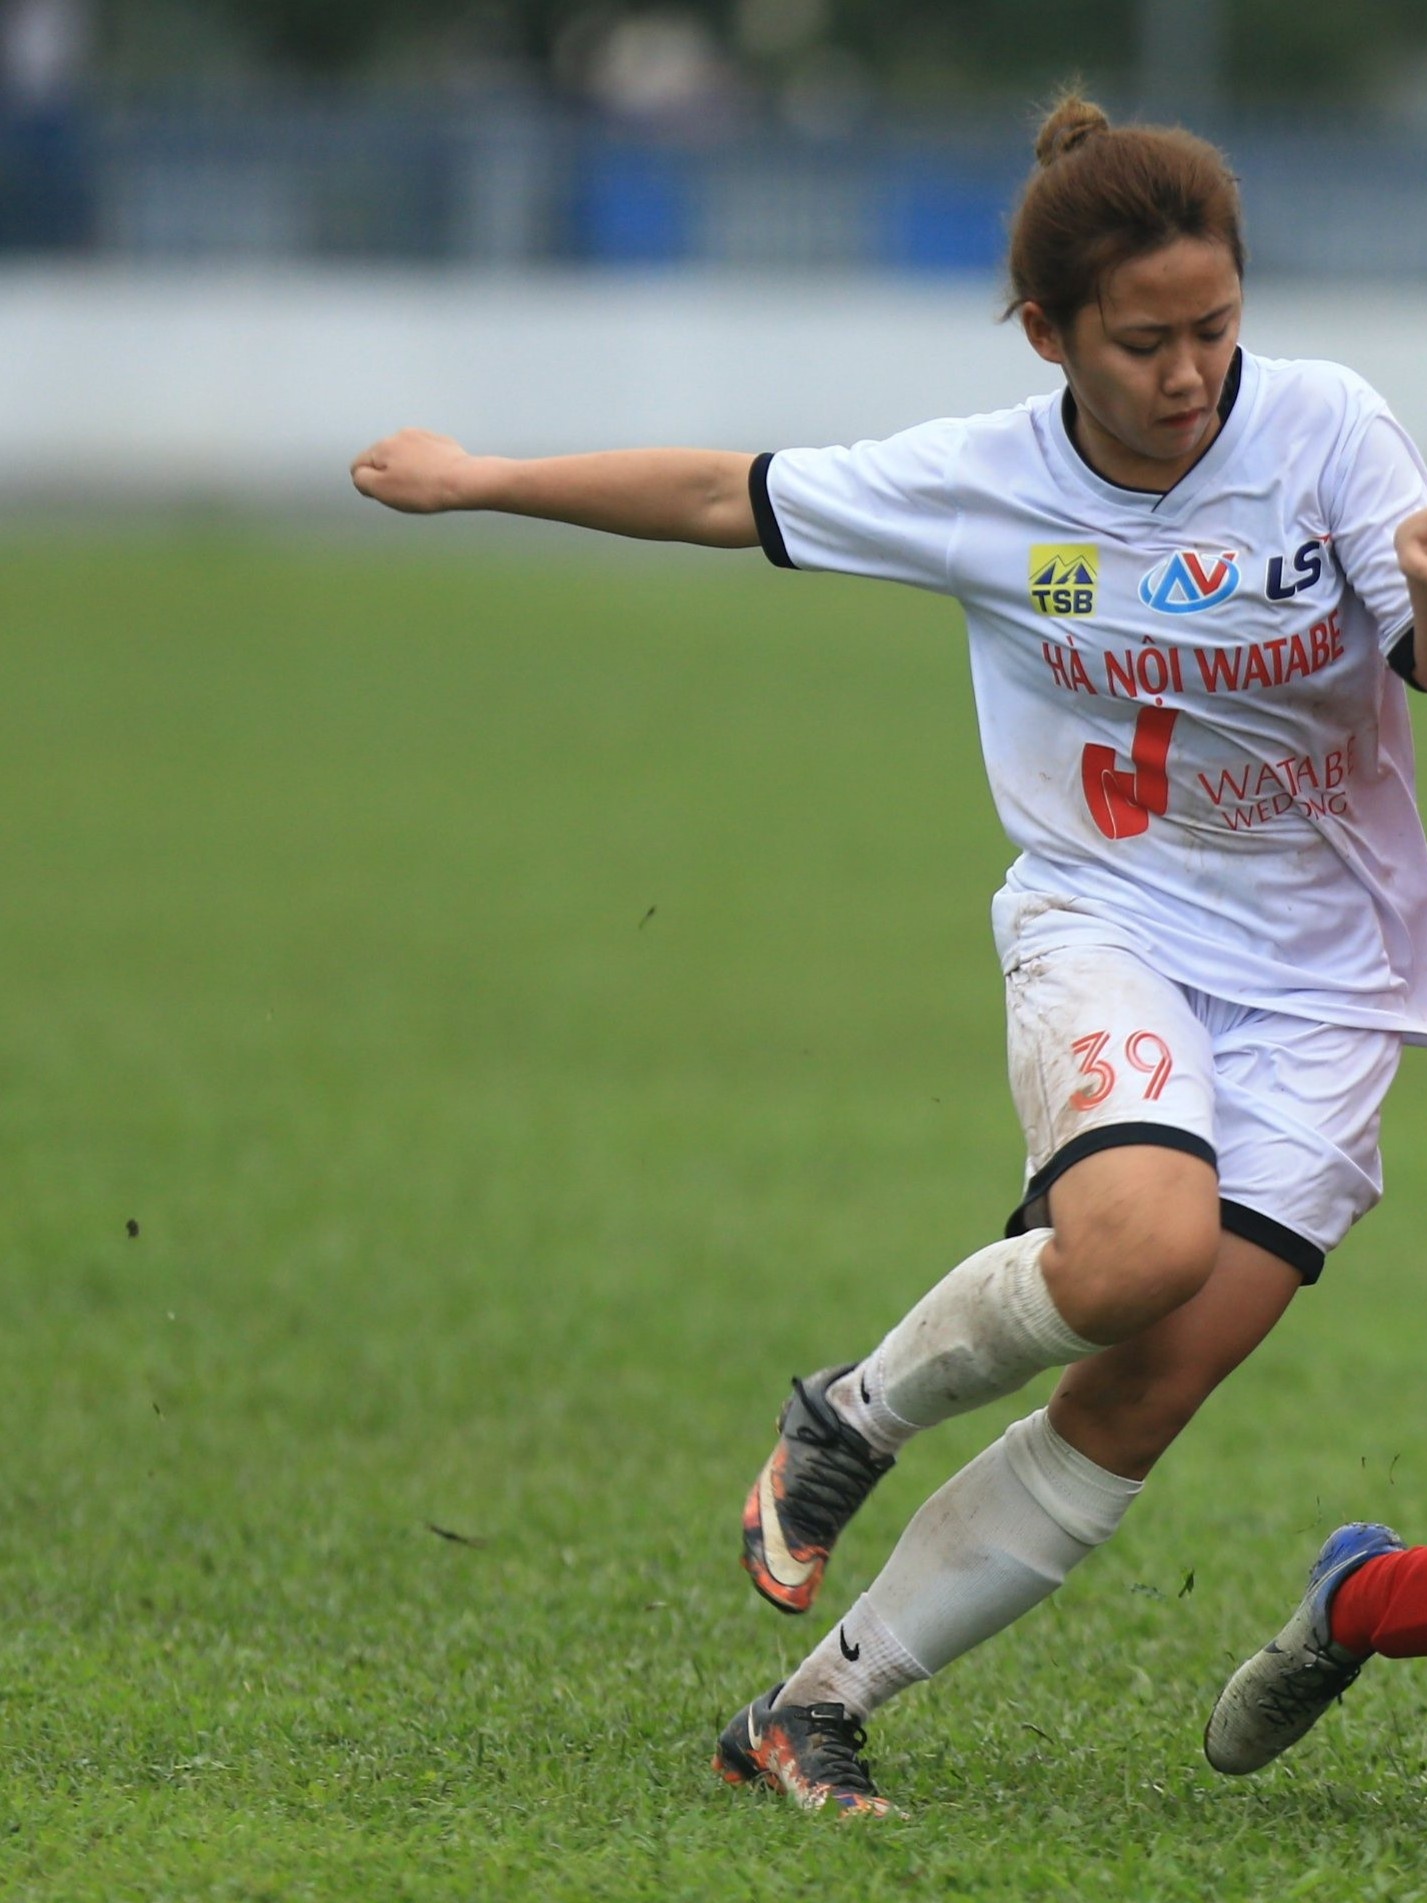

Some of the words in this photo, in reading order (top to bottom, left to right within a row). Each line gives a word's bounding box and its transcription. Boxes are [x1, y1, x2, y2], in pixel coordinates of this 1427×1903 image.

[1031, 589, 1093, 614] TSB
[1265, 540, 1322, 601] LS
[1041, 635, 1098, 696] HÀ
[1103, 635, 1184, 707] NỘI
[1193, 608, 1345, 694] WATABE
[1068, 1029, 1173, 1112] 39
